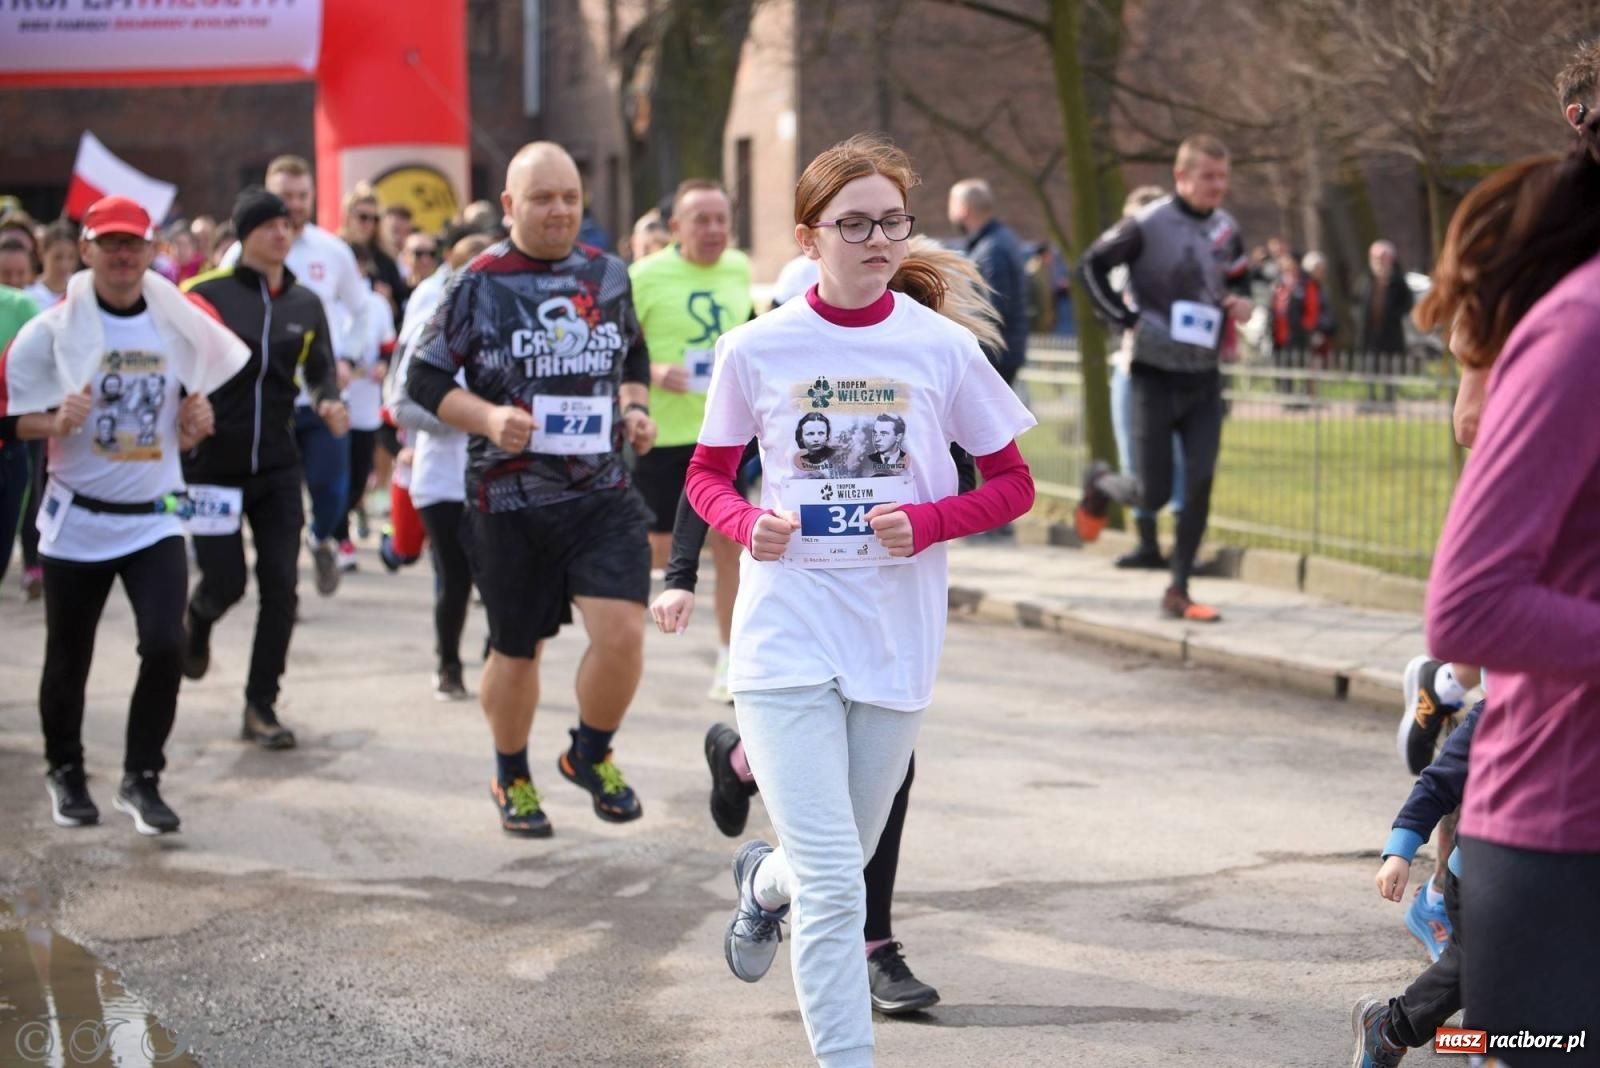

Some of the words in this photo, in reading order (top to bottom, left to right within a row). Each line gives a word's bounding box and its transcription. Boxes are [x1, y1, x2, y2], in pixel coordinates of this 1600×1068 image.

[524, 350, 614, 378] TRENING
[837, 381, 867, 389] TROPEM
[838, 389, 895, 402] WILCZYM
[563, 416, 589, 434] 27
[837, 489, 874, 499] WILCZYM
